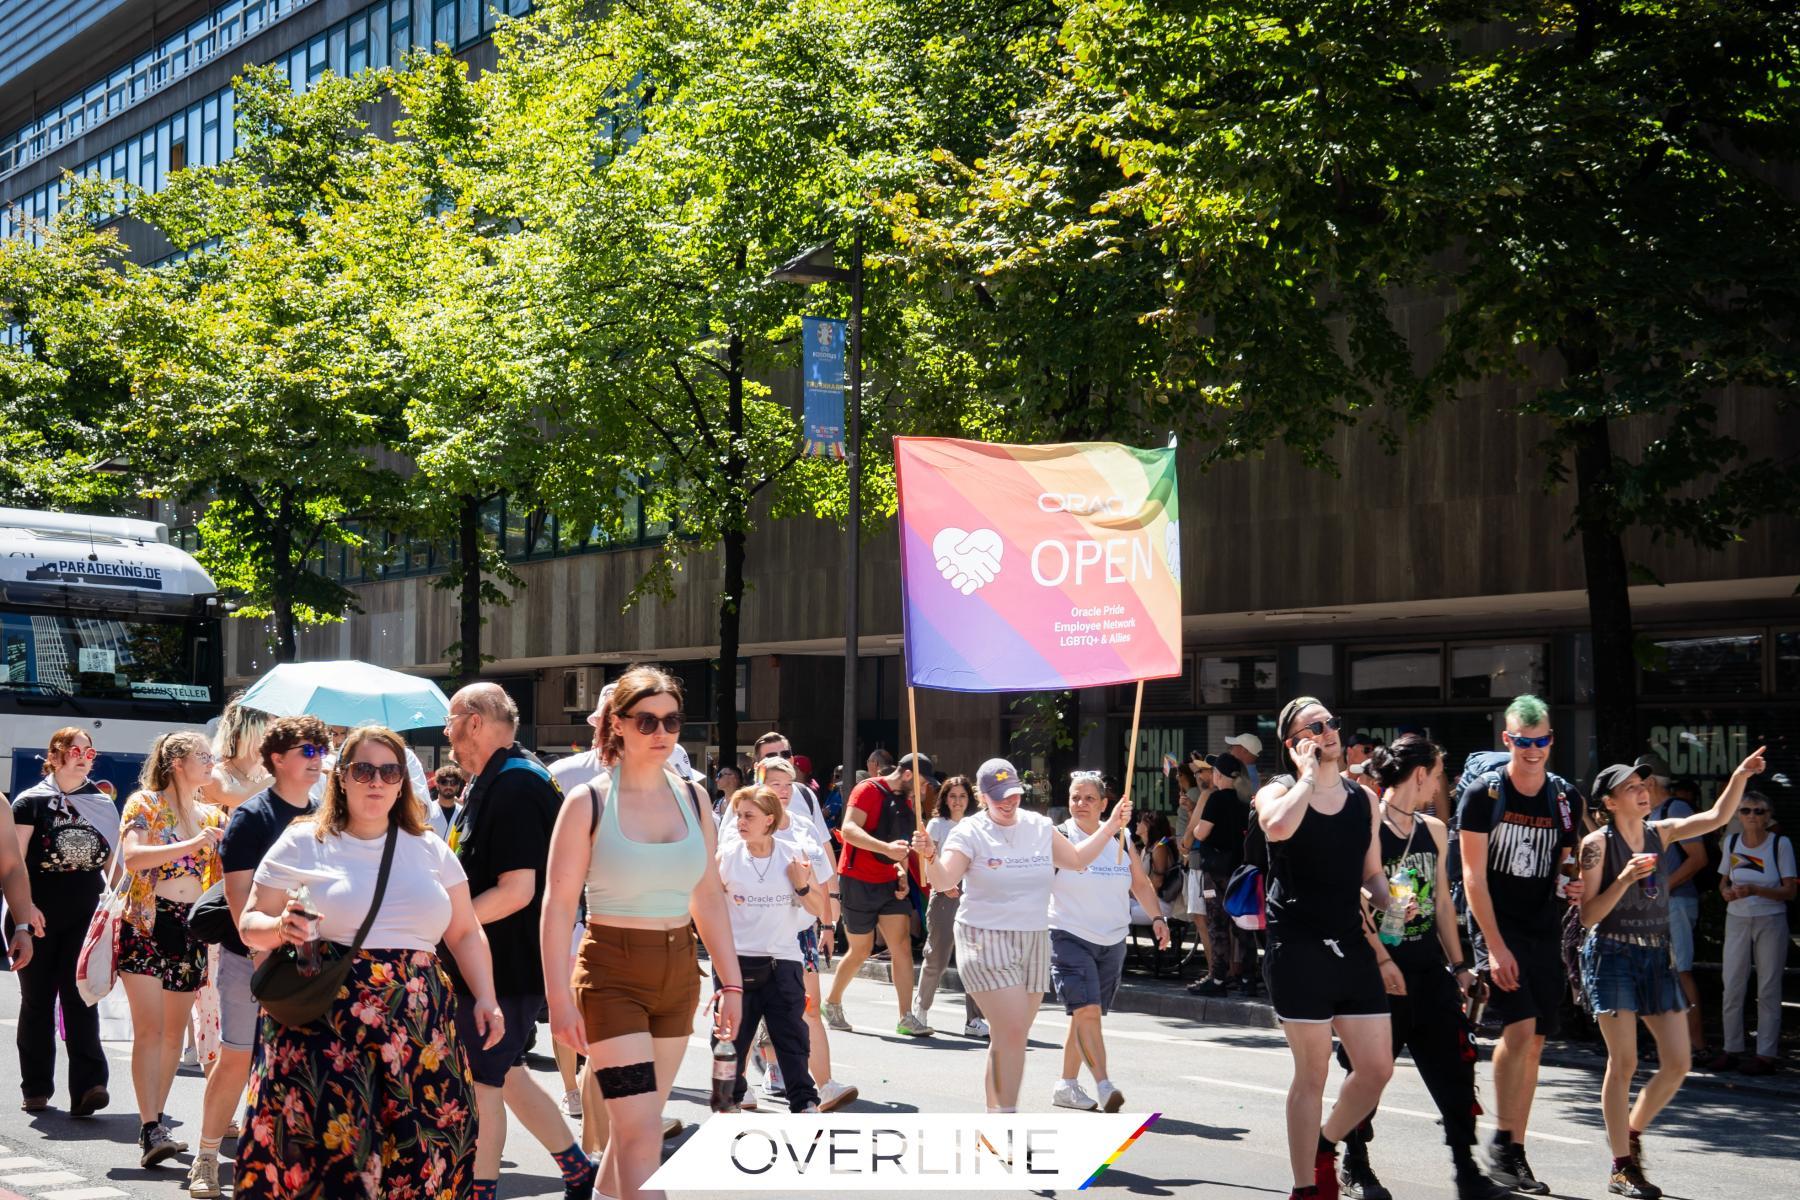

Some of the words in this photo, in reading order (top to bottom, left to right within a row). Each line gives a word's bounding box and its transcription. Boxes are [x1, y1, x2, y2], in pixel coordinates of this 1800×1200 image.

[1031, 536, 1153, 587] OPEN
[59, 560, 162, 580] PARADEKING.DE
[1071, 606, 1101, 617] Oracle
[1103, 604, 1125, 615] Pride
[1054, 621, 1101, 633] Employee
[1103, 617, 1136, 629] Network
[1060, 635, 1098, 647] LGBTQ+
[1101, 634, 1107, 644] &
[1108, 632, 1131, 644] Allies
[1650, 725, 1748, 775] SCHAU
[1004, 856, 1029, 864] Oracle
[1090, 865, 1112, 873] Oracle
[747, 895, 774, 903] Oracle
[775, 894, 792, 903] OPE
